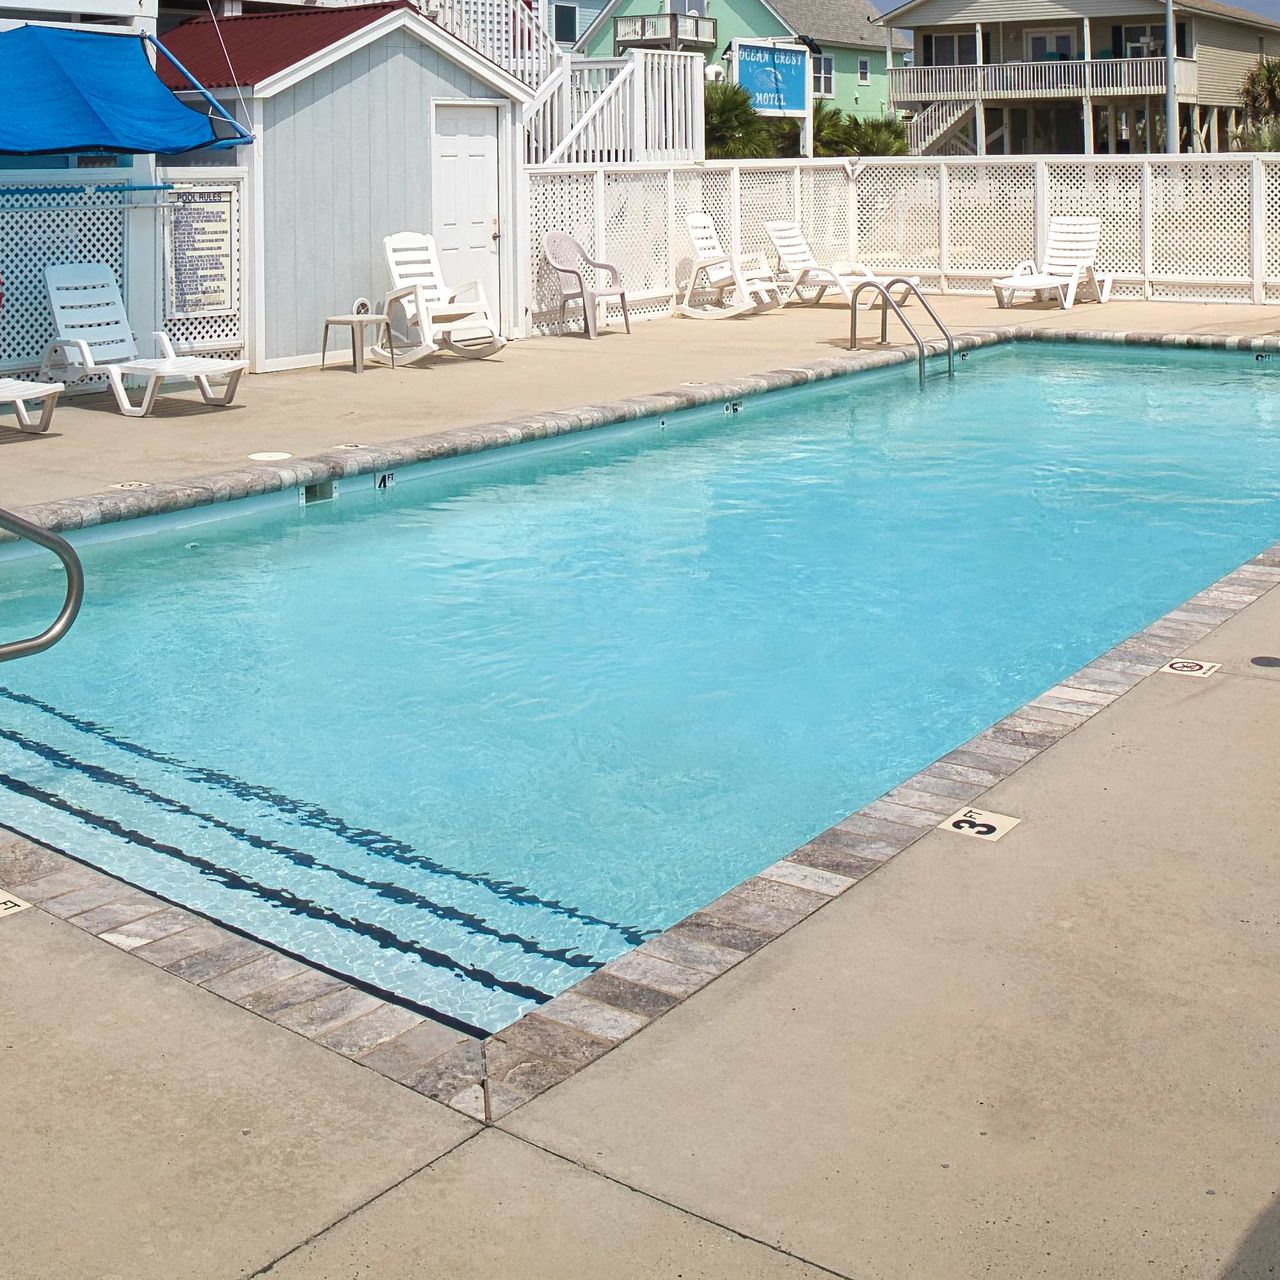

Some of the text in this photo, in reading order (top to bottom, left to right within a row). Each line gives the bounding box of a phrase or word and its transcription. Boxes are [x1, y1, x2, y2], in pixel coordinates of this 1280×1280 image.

[739, 48, 802, 65] OCEAN CREST
[755, 92, 786, 106] MOTEL
[176, 193, 222, 201] POOL RULES
[951, 809, 997, 835] 3 FT
